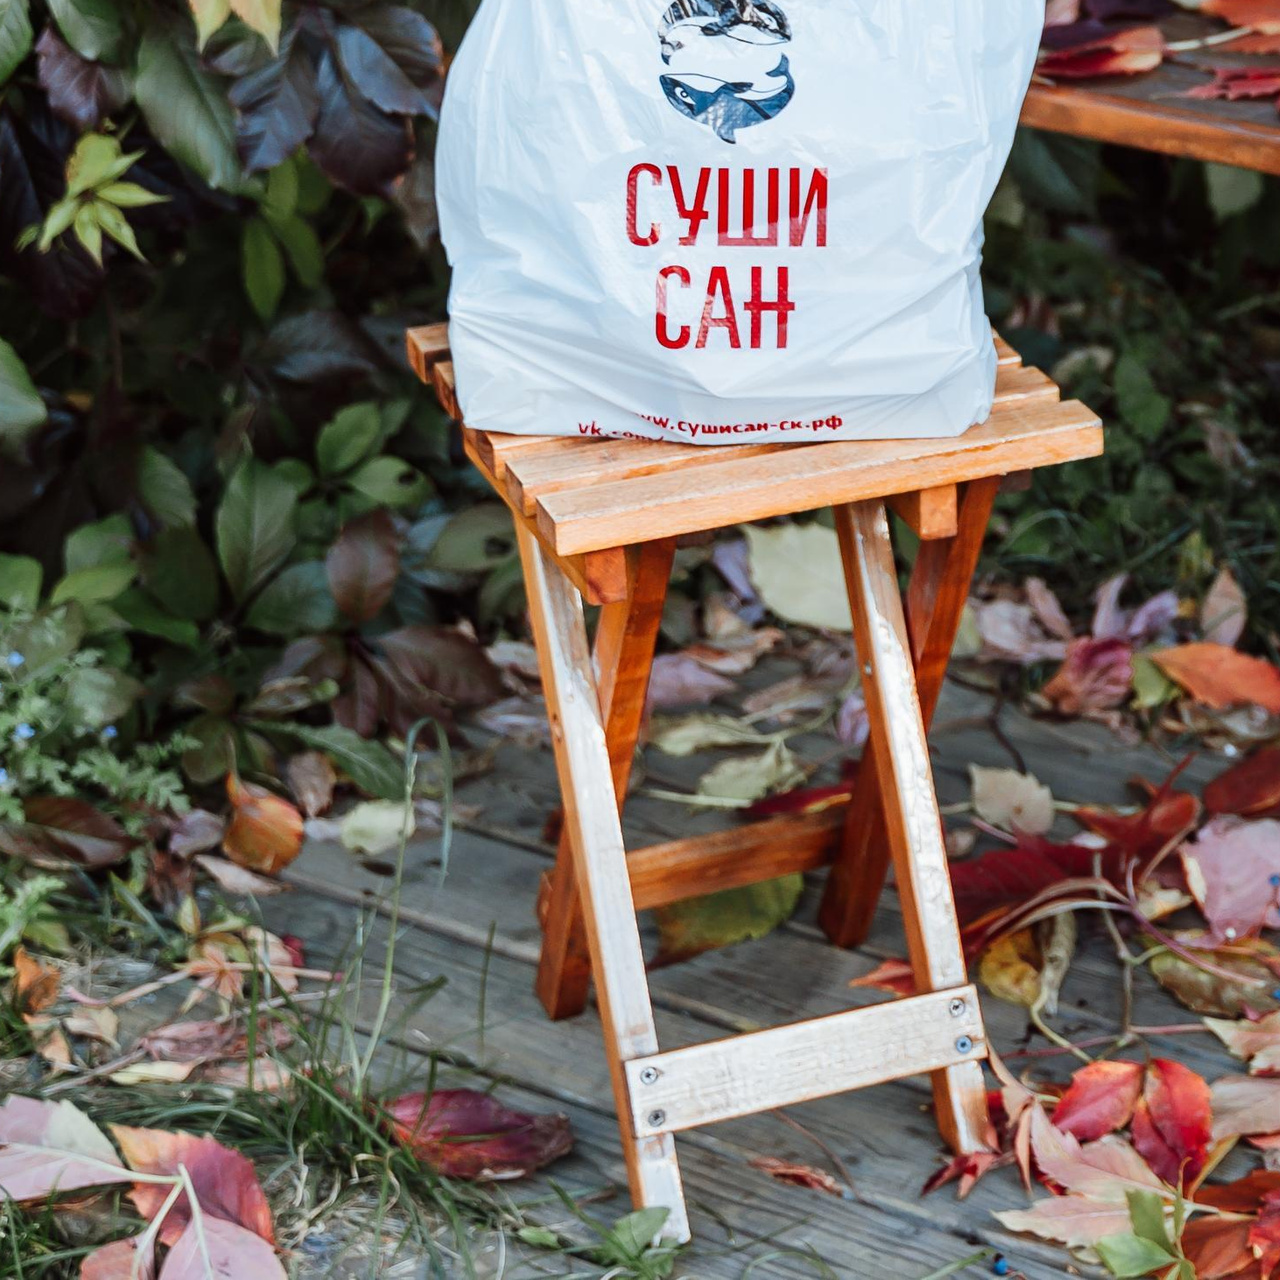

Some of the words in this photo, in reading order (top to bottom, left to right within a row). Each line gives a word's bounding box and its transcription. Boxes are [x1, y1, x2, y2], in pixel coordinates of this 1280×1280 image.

[626, 163, 828, 247] СУШИ
[655, 265, 796, 350] САН
[635, 413, 844, 437] w.сушисан-ск.рф
